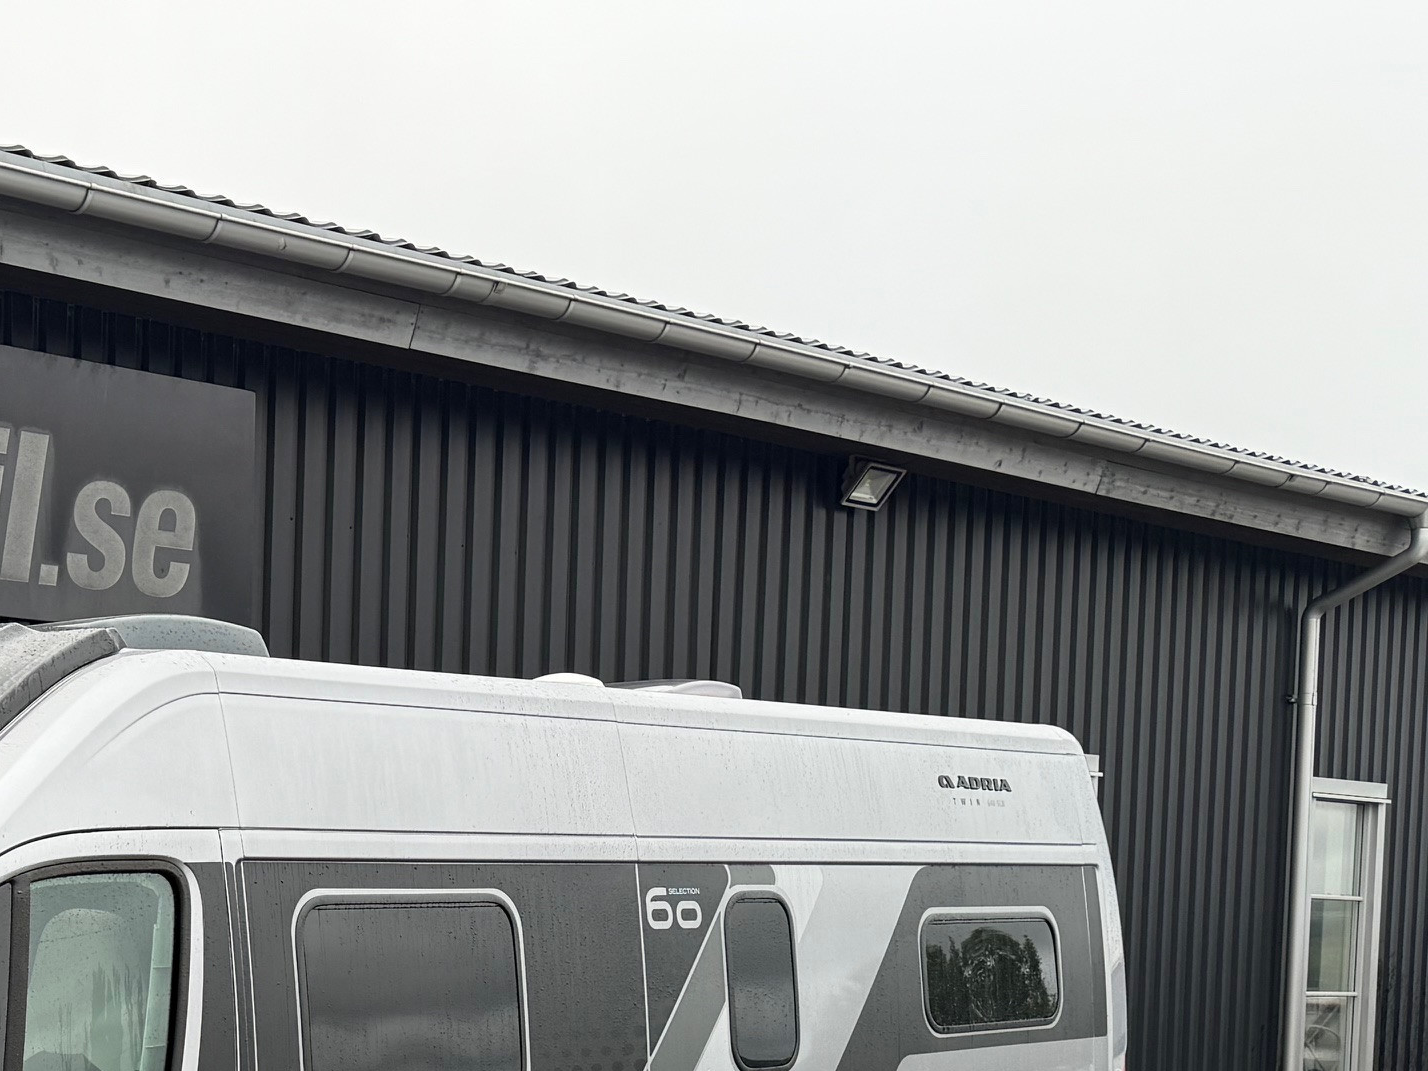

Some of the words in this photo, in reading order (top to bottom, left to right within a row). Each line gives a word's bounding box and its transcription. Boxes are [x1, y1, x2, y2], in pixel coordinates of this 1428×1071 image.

[956, 775, 1012, 792] ADRIA
[668, 887, 701, 895] SELECTION
[645, 887, 702, 930] 60
